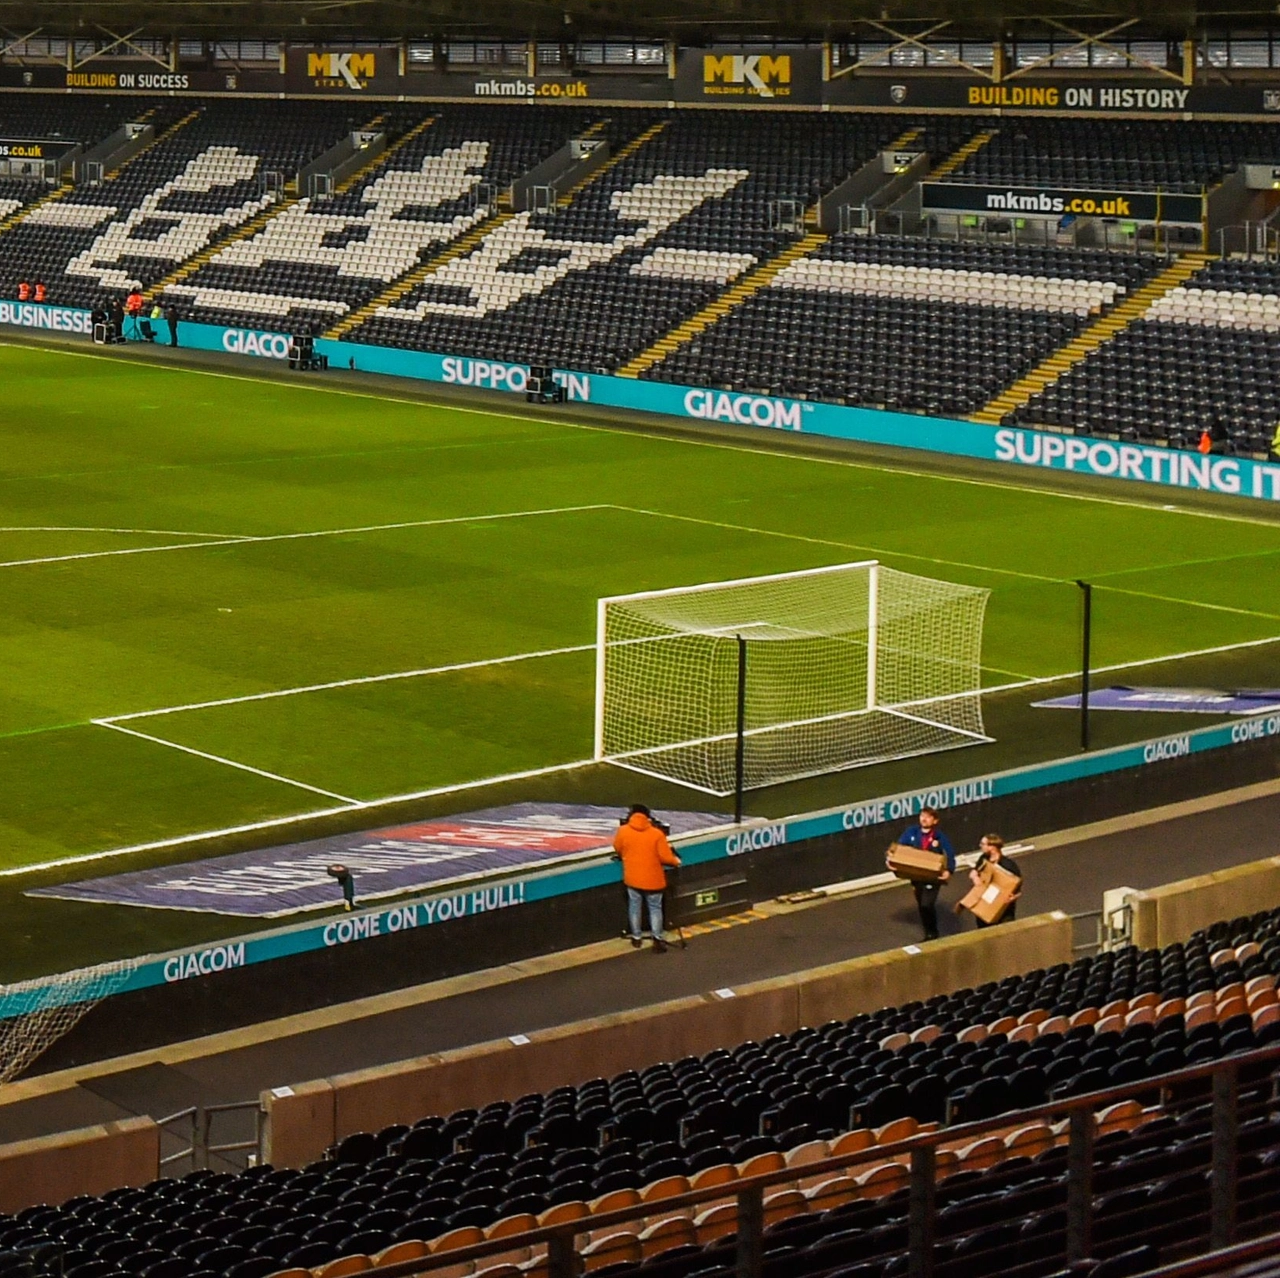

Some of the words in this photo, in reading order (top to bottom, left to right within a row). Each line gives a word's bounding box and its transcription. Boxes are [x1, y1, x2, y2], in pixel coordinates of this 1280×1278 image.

[66, 73, 116, 87] BUILDING
[119, 74, 135, 88] ON
[138, 74, 189, 89] SUCCESS
[308, 53, 375, 90] MKM
[703, 55, 790, 98] MKM
[474, 79, 588, 97] mkmbs.co.uk
[968, 86, 1059, 106] BUILDING
[1065, 88, 1093, 107] ON
[1100, 88, 1190, 109] HISTORY
[986, 191, 1130, 216] mkmbs.co.uk
[222, 328, 294, 359] GIACO
[995, 428, 1240, 494] SUPPORTING
[1231, 722, 1265, 743] COME
[1144, 735, 1189, 763] GIACOM
[842, 803, 886, 830] COME
[890, 799, 914, 819] ON
[915, 790, 949, 816] YOU
[953, 779, 993, 805] HULL!
[726, 824, 786, 856] GIACOM
[322, 915, 381, 948] COME
[387, 909, 417, 933] ON
[422, 896, 466, 925] YOU
[472, 882, 525, 914] HULL!
[163, 942, 245, 983] GIACOM
